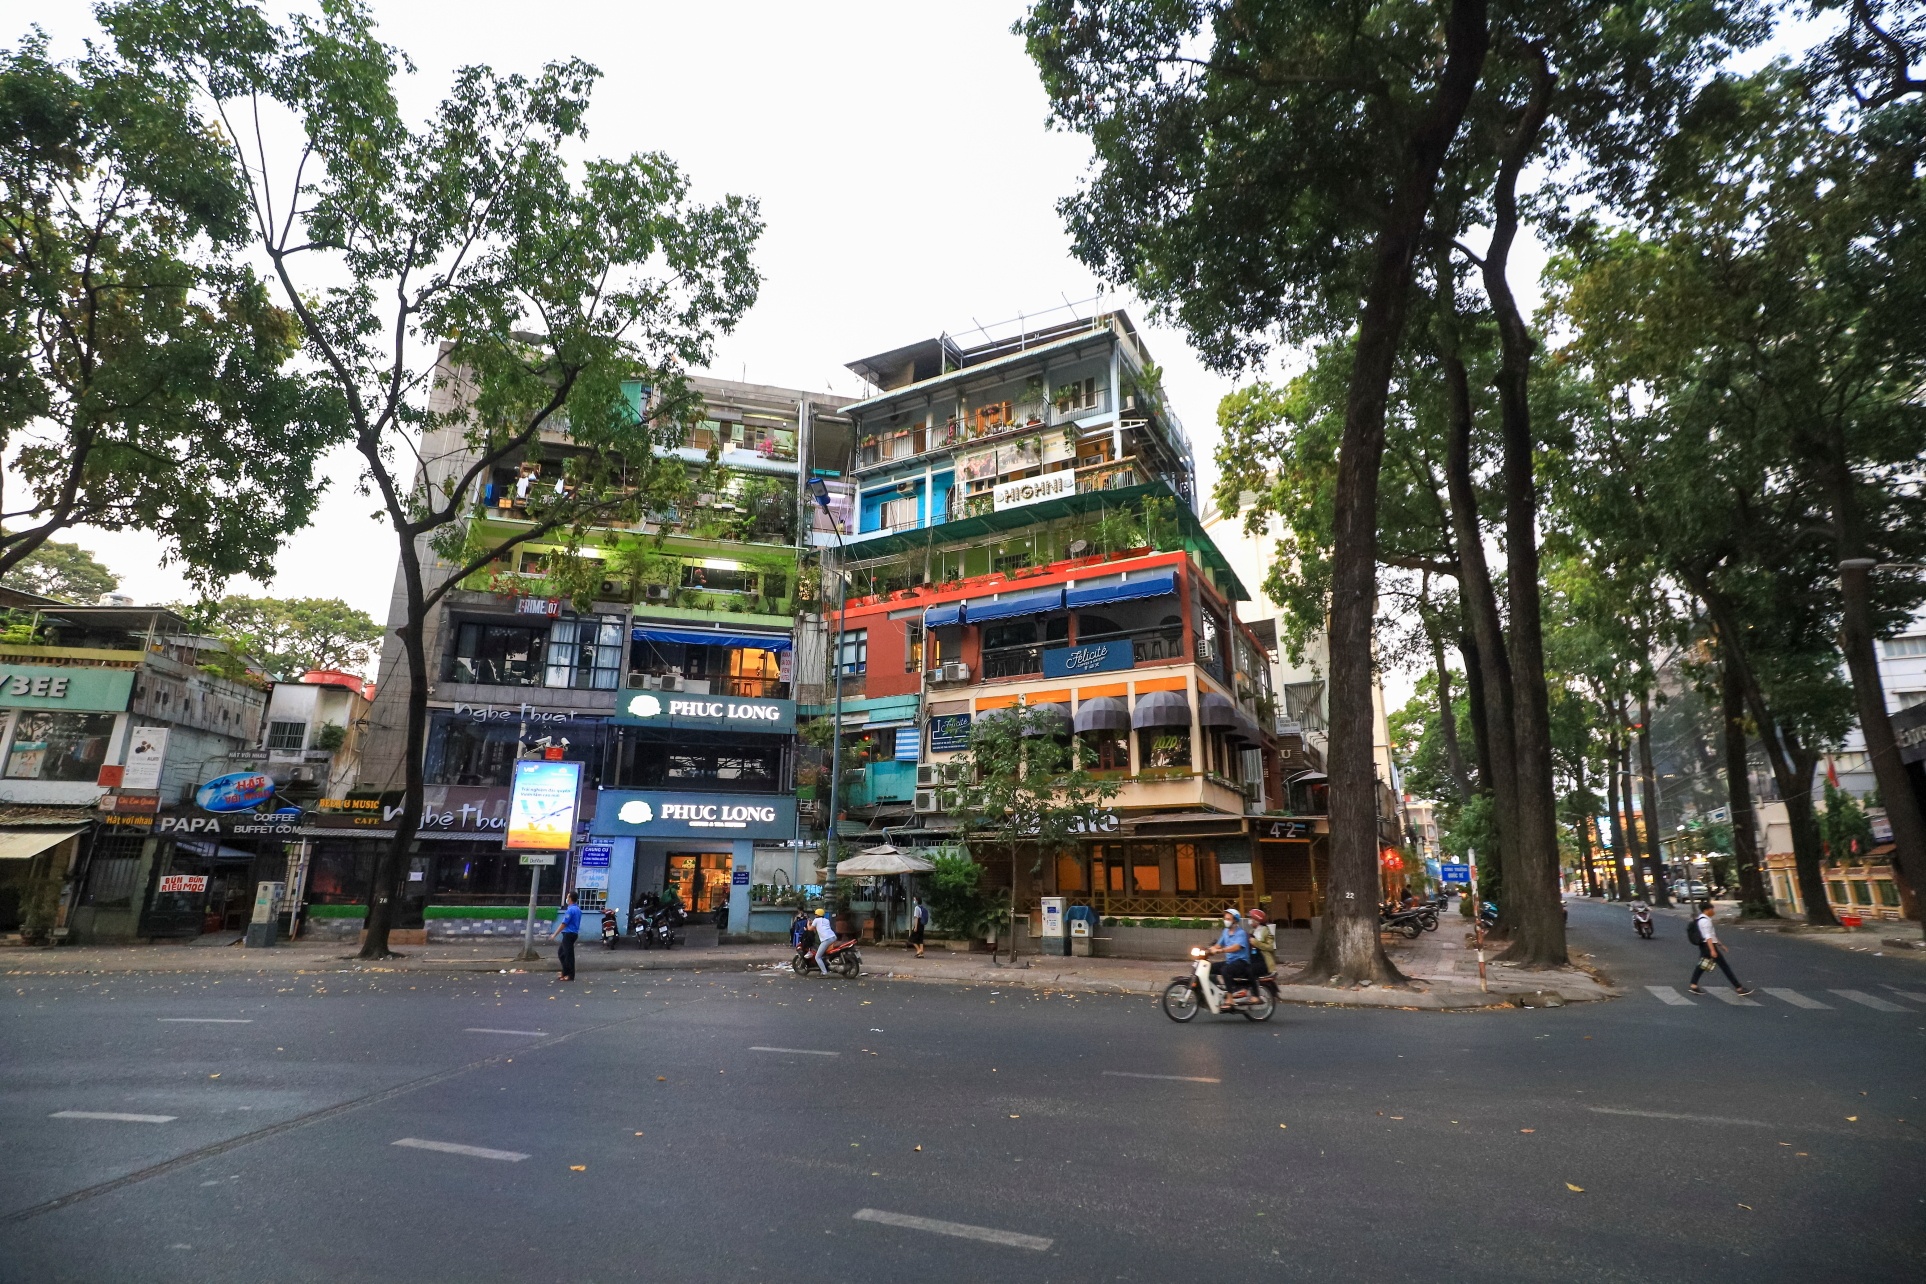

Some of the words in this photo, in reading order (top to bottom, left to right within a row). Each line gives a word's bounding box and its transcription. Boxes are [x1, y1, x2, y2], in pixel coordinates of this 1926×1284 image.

[547, 603, 558, 614] 07
[669, 701, 723, 717] PHUC
[728, 704, 780, 720] LONG
[319, 798, 341, 808] BEER
[352, 800, 380, 809] MUSIC
[253, 813, 295, 822] COFFEE
[661, 804, 717, 820] PHUC
[721, 806, 775, 822] LONG
[160, 817, 221, 833] PAPA
[354, 817, 380, 825] CAFE
